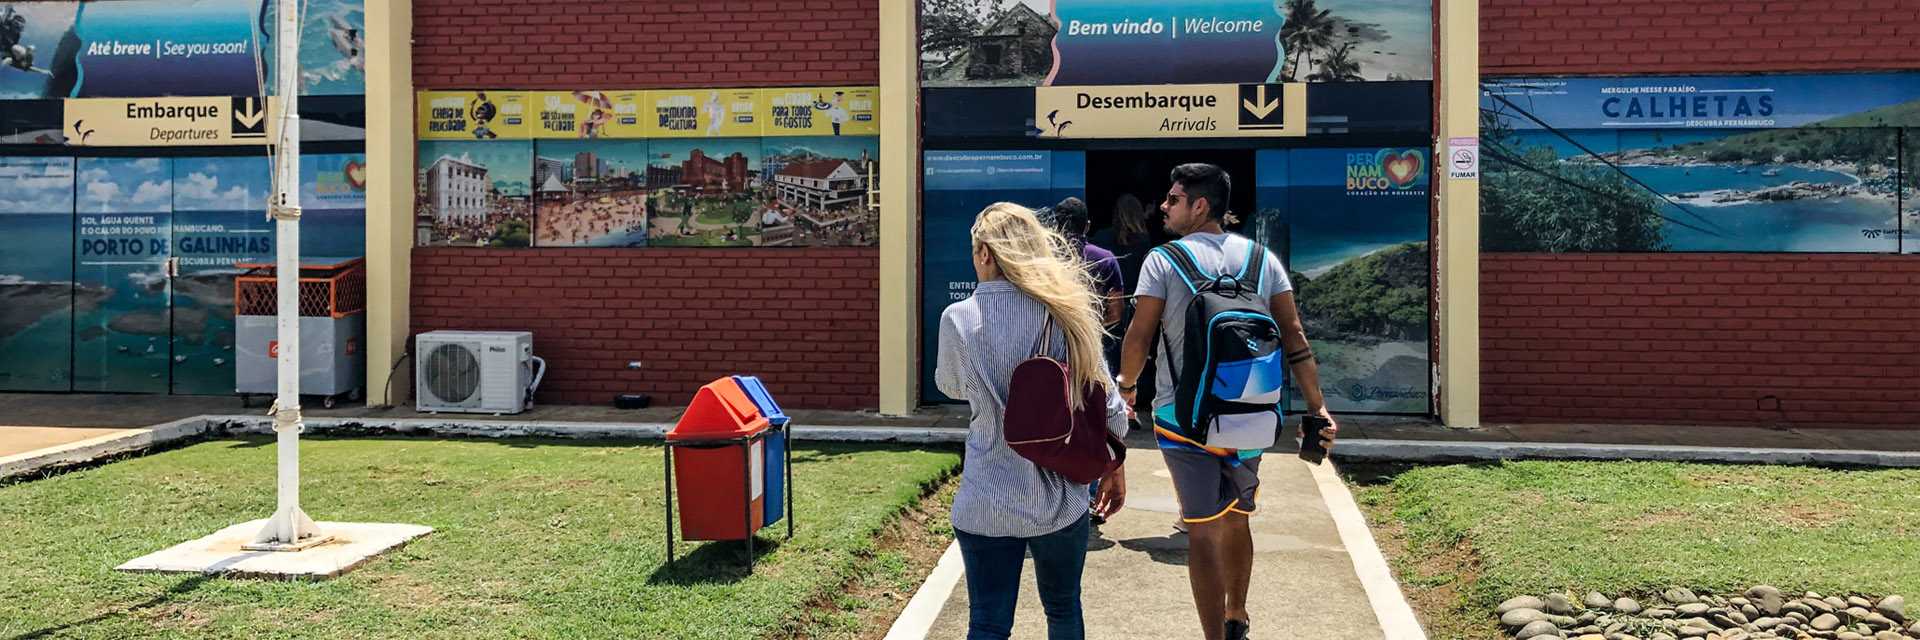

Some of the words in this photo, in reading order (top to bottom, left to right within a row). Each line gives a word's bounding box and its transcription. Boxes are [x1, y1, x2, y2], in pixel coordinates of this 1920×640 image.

[1068, 19, 1107, 36] Bem
[1112, 17, 1164, 35] vindo
[1184, 17, 1263, 34] Welcome
[87, 40, 110, 56] Até
[113, 40, 151, 55] breve
[163, 41, 185, 55] See
[186, 44, 211, 58] you
[212, 40, 248, 54] soon!
[1076, 91, 1217, 112] Desembarque
[1601, 95, 1774, 118] CALHETAS
[126, 102, 219, 122] Embarque
[1159, 116, 1217, 132] Arrivals
[150, 127, 219, 143] Departures
[1346, 153, 1375, 166] PER
[1346, 165, 1381, 178] NAM
[1346, 177, 1390, 190] BUCO
[100, 215, 123, 225] ÁGUA
[123, 216, 154, 225] QUENTE
[94, 226, 121, 234] CALOR
[122, 226, 131, 234] DO
[134, 226, 156, 234] POVO
[82, 238, 144, 256] PORTO
[150, 238, 170, 255] DE
[179, 236, 270, 254] GALINHAS
[949, 281, 977, 290] ENTRE
